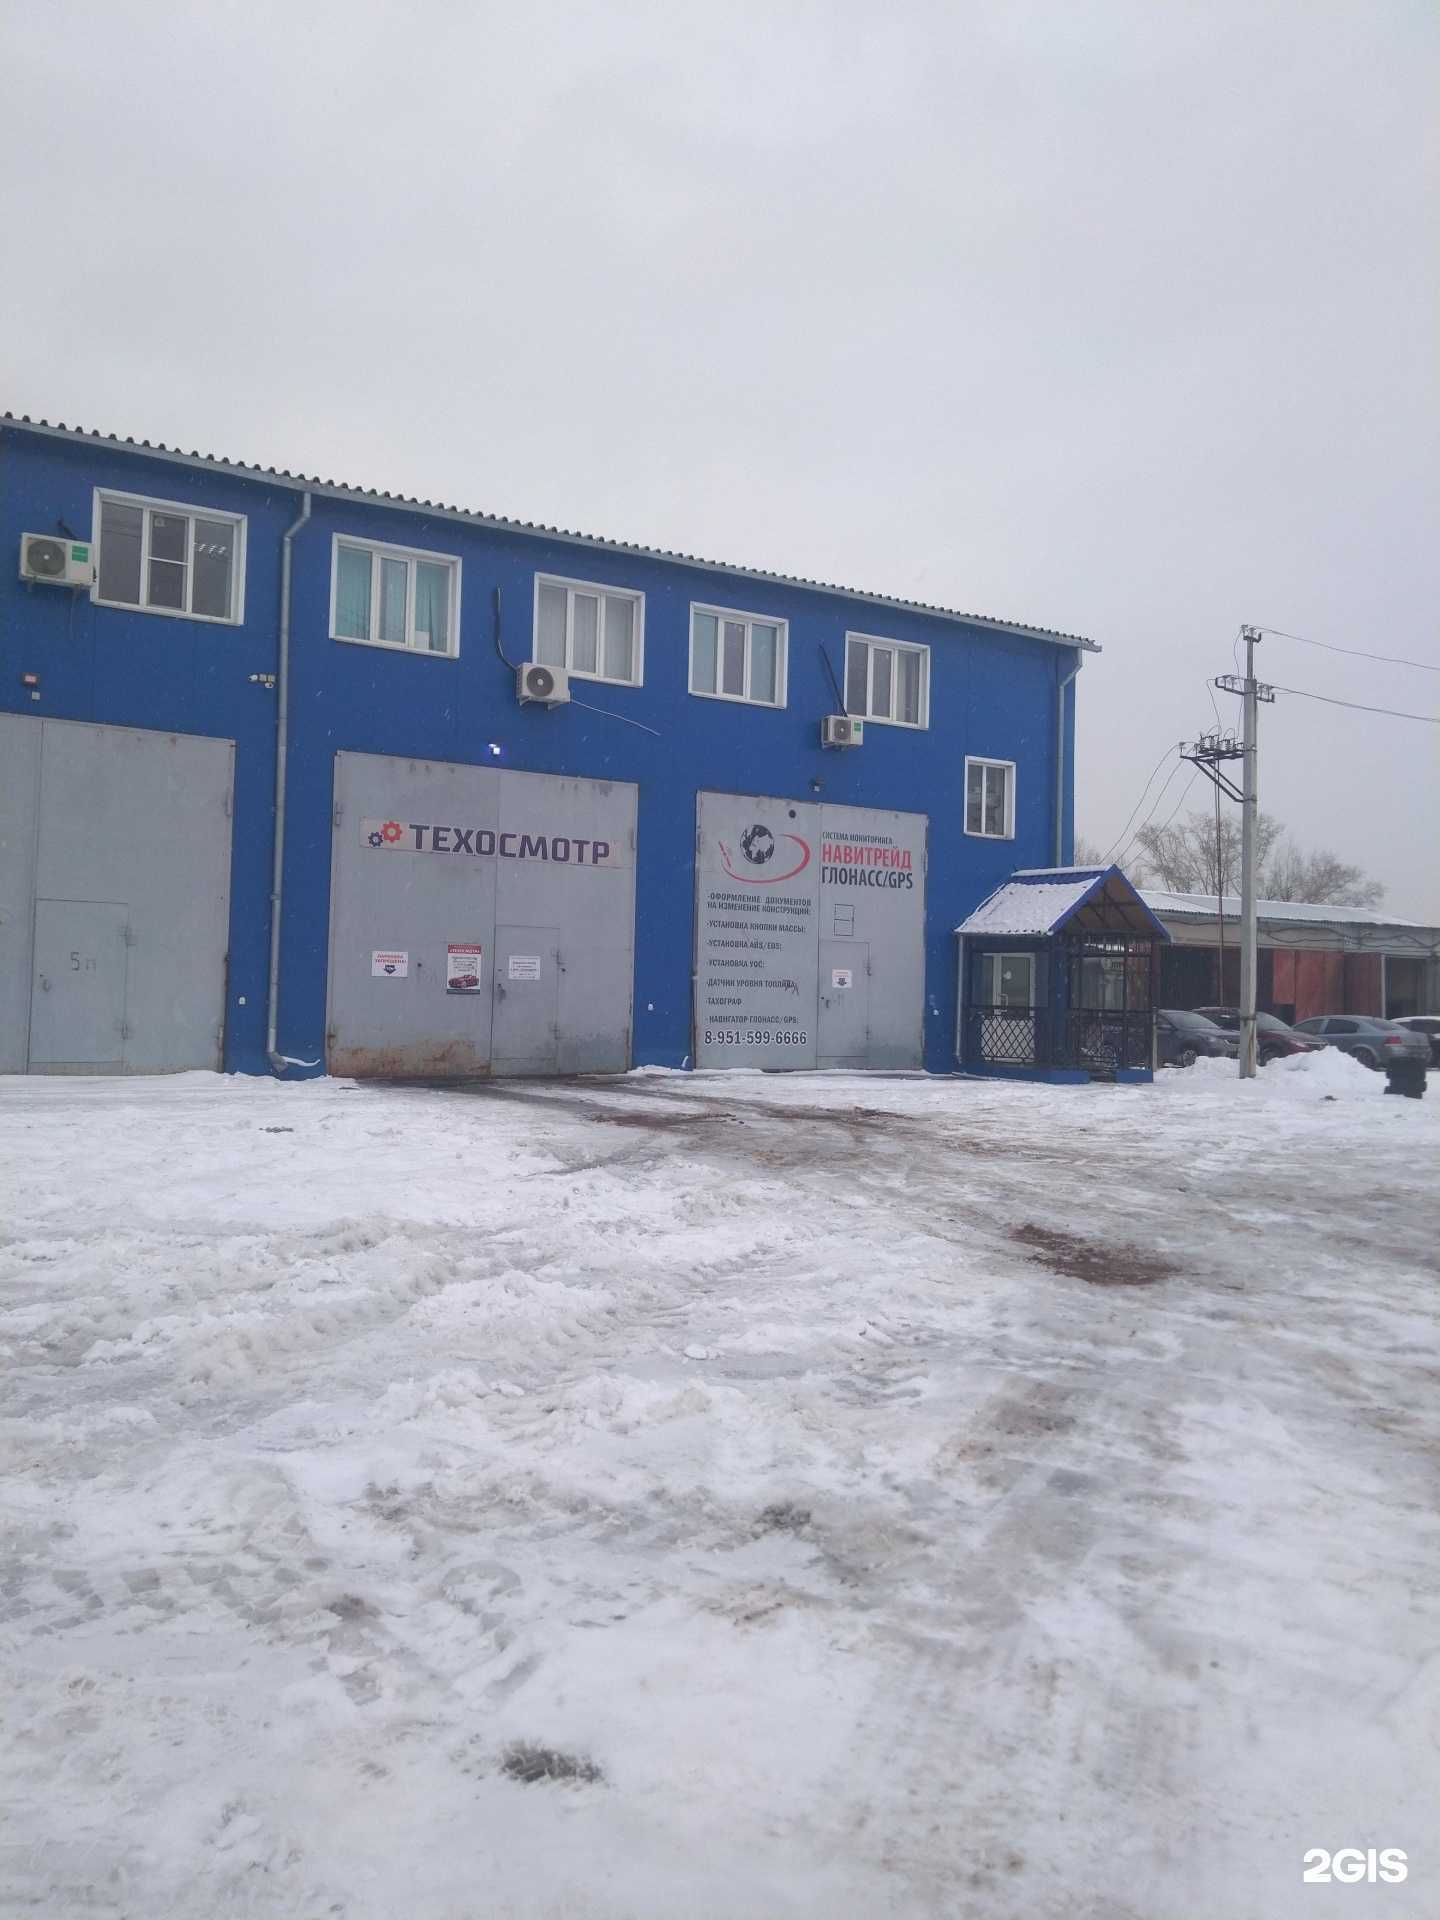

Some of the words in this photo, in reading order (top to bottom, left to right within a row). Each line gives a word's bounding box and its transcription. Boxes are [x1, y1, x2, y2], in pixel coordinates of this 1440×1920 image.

[822, 831, 849, 841] СИСТЕМА
[409, 824, 610, 865] ТЕХОСМОТР
[822, 843, 912, 871] НАВИТРЕЙД
[821, 866, 913, 889] ГЛОНАСС/GPS
[707, 901, 717, 910] НА
[718, 902, 760, 912] ИЗМЕНЕНИЕ
[736, 979, 763, 988] УРОВНЯ
[704, 1030, 807, 1045] 8-951-599-6666
